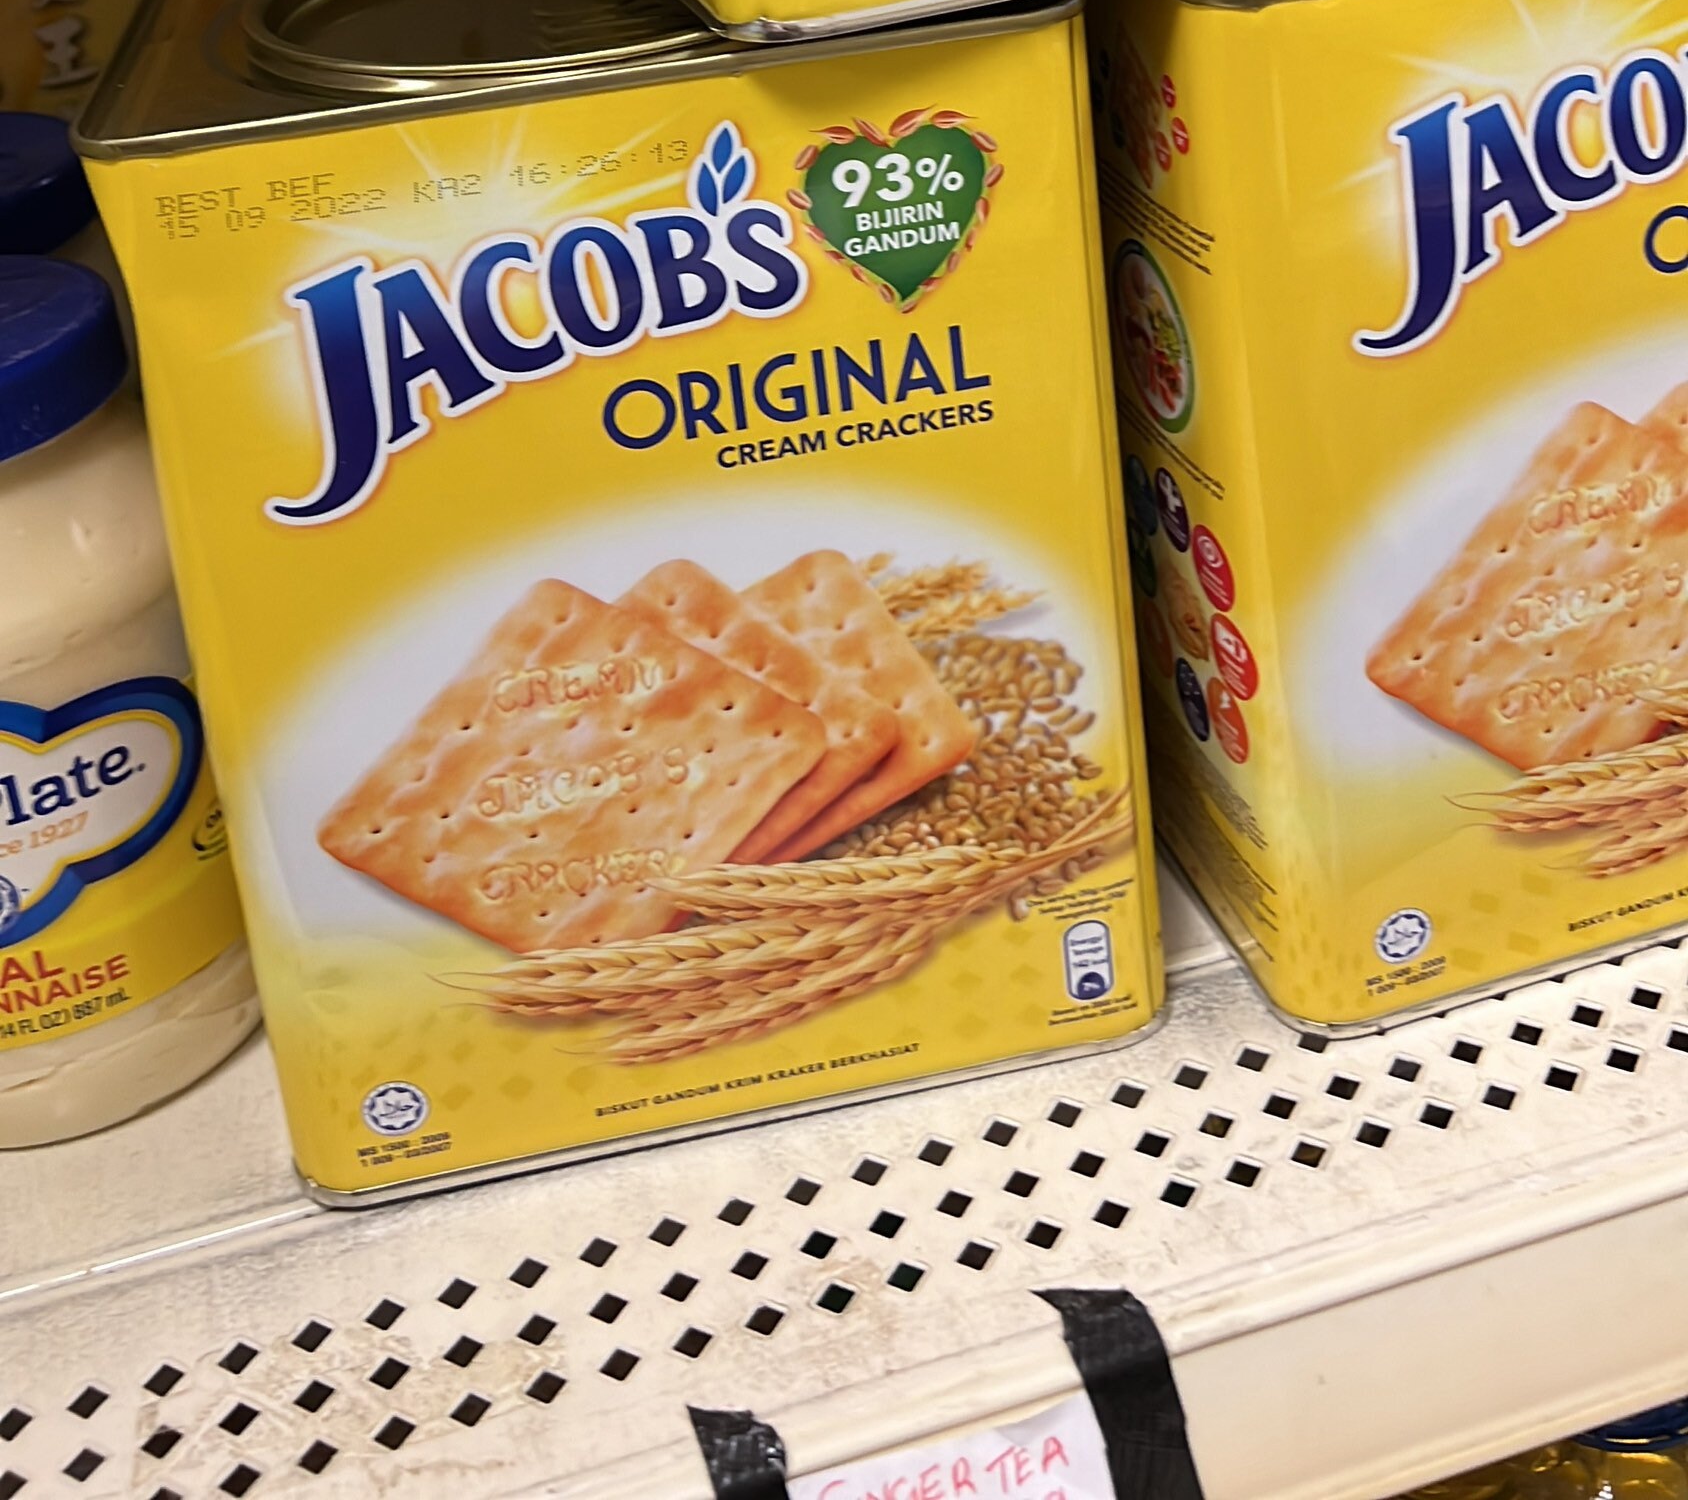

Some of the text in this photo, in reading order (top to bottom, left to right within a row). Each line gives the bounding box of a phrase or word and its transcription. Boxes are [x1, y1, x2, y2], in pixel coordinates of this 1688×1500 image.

[154, 172, 335, 218] BEST BEF
[290, 188, 387, 222] 2022
[831, 153, 966, 209] 93%
[1359, 52, 1688, 350] JACO
[843, 221, 961, 258] GANDUM
[855, 201, 945, 233] BIJIRIN
[602, 324, 992, 450] ORIGINAL
[716, 400, 995, 469] CREAM CRACKERS
[0, 745, 146, 826] late.
[30, 811, 88, 849] 1927
[985, 1435, 1070, 1494] TEA
